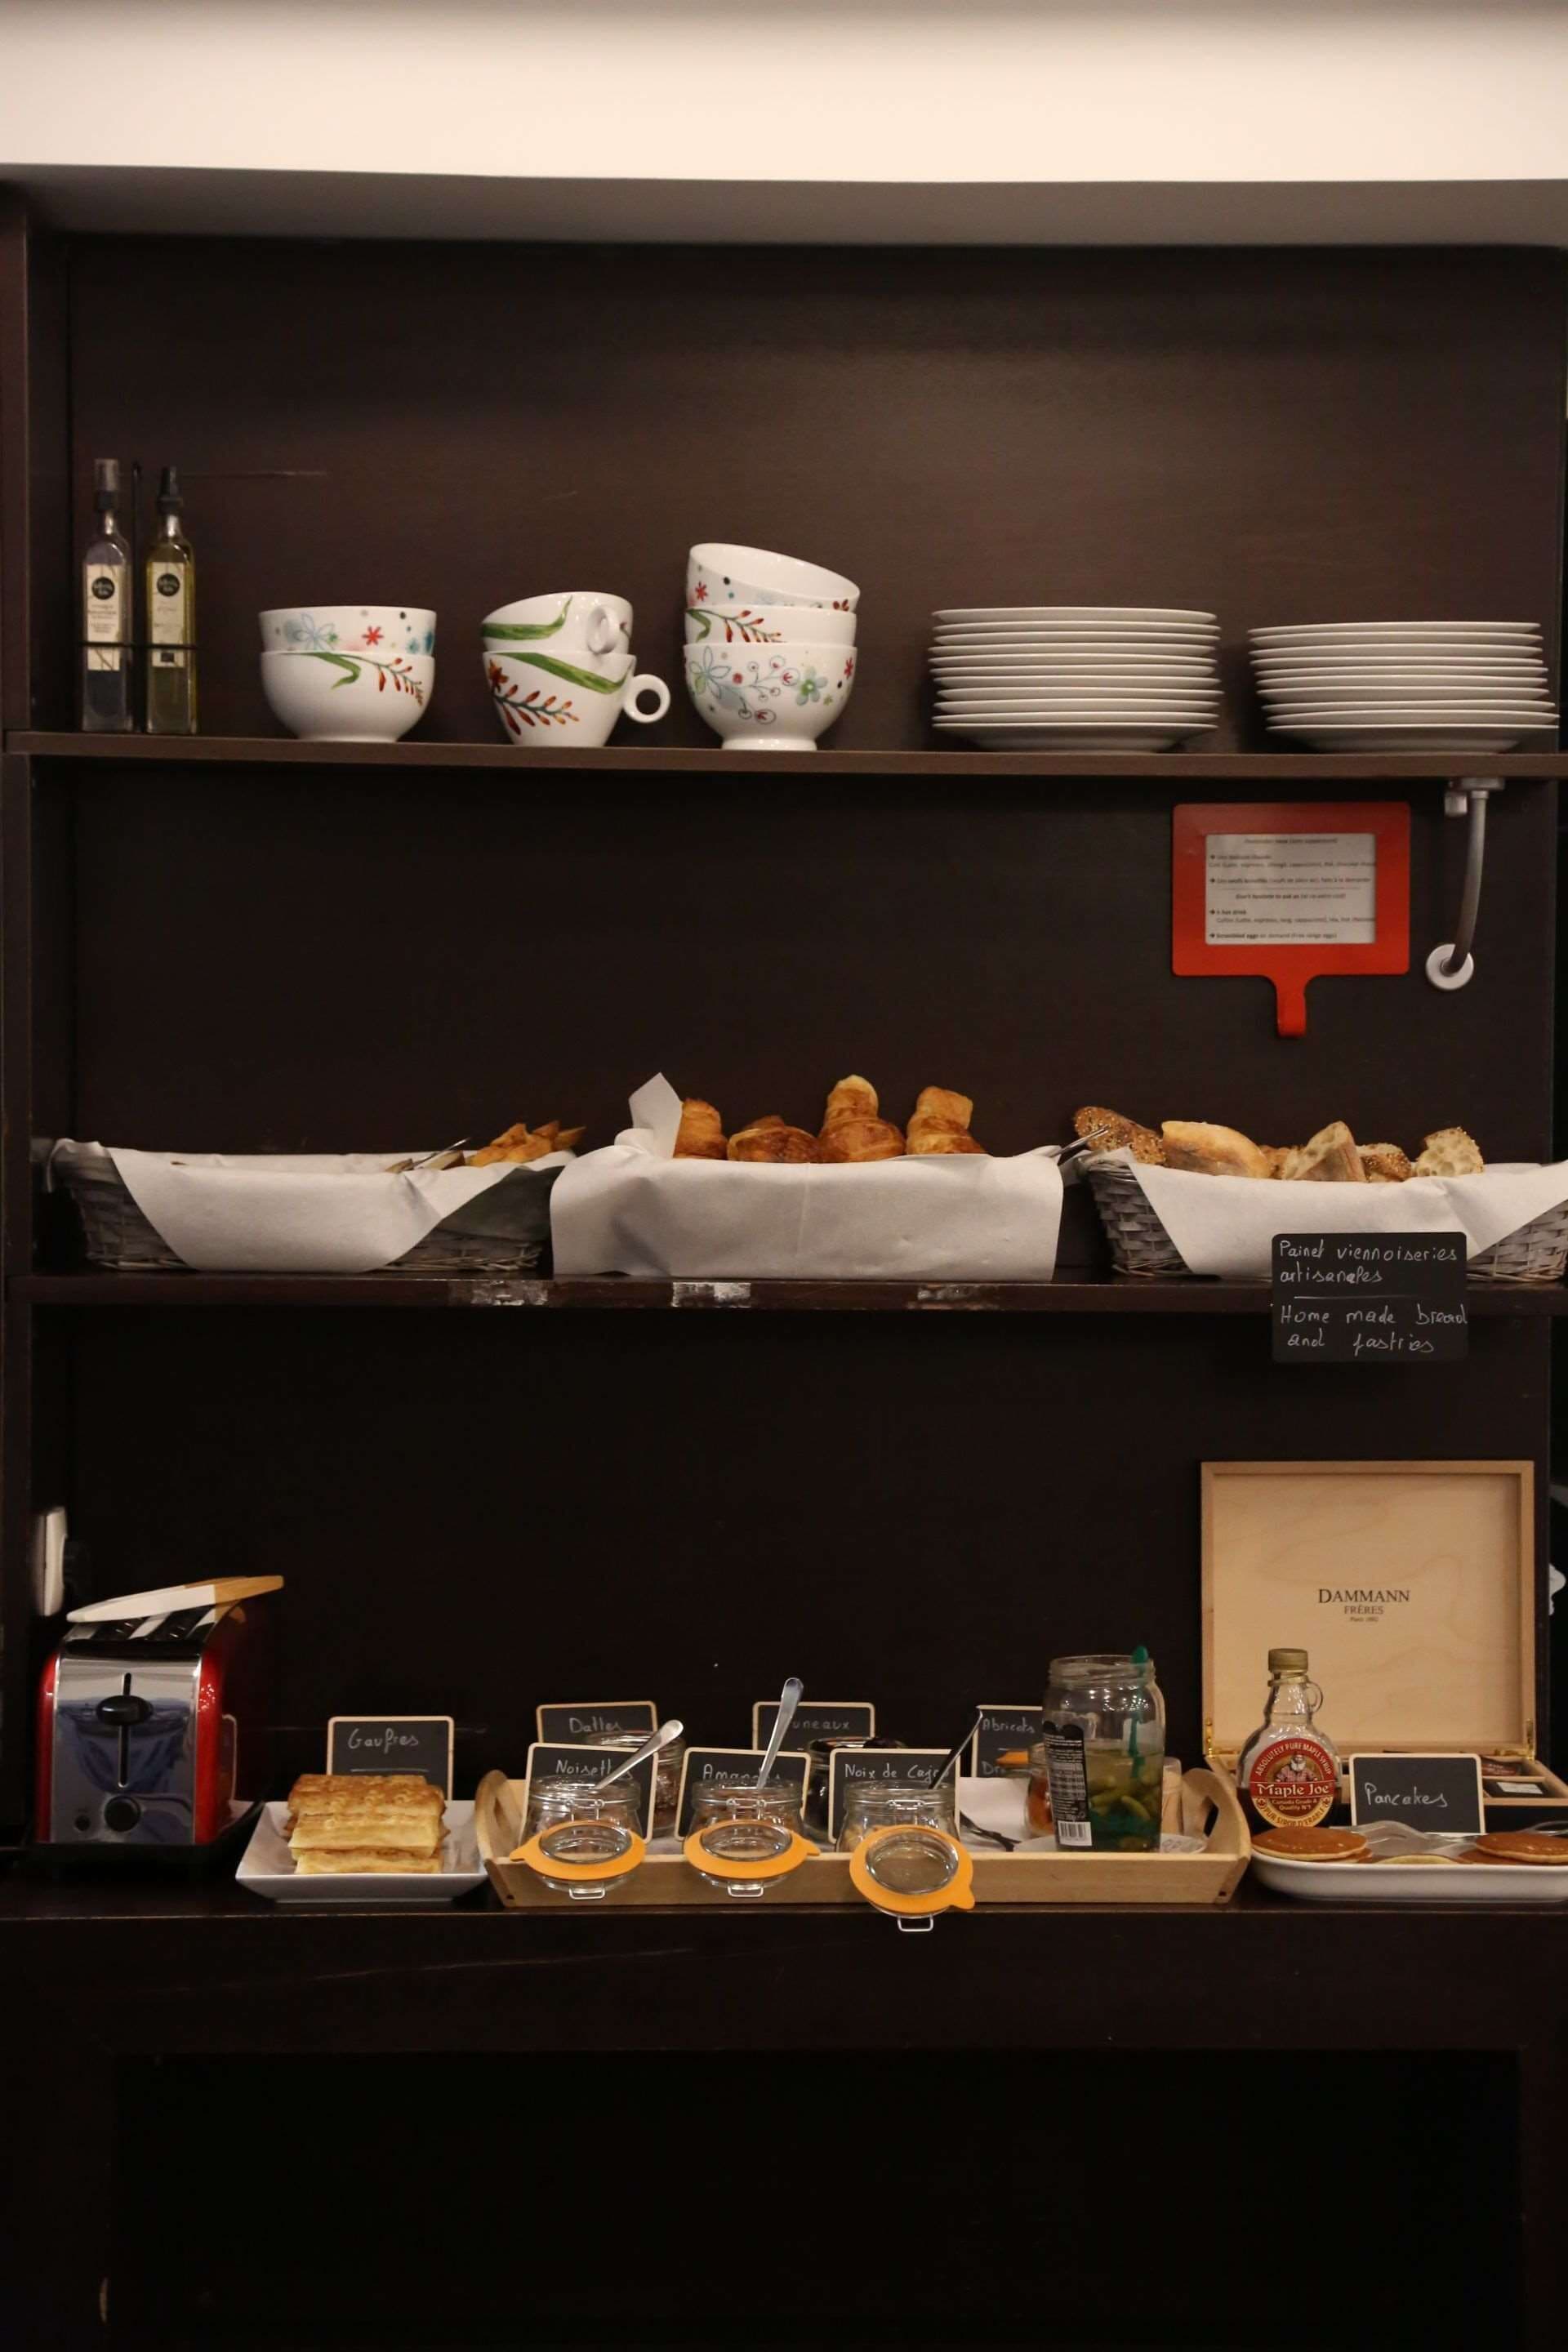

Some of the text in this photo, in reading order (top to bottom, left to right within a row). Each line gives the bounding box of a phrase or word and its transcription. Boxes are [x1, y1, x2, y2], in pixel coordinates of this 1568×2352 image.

[1337, 1244, 1458, 1262] viennoiseries
[1280, 1261, 1383, 1284] artisanales
[1281, 1303, 1468, 1325] Home made bread
[1288, 1328, 1326, 1348] and
[1318, 1588, 1410, 1604] DAMMANN
[982, 1717, 1036, 1733] Abricots
[555, 1759, 634, 1780] Noisetts
[844, 1763, 875, 1779] Noix
[882, 1762, 898, 1778] de
[1257, 1783, 1330, 1797] Maple Joe
[1365, 1783, 1449, 1807] Pancakes
